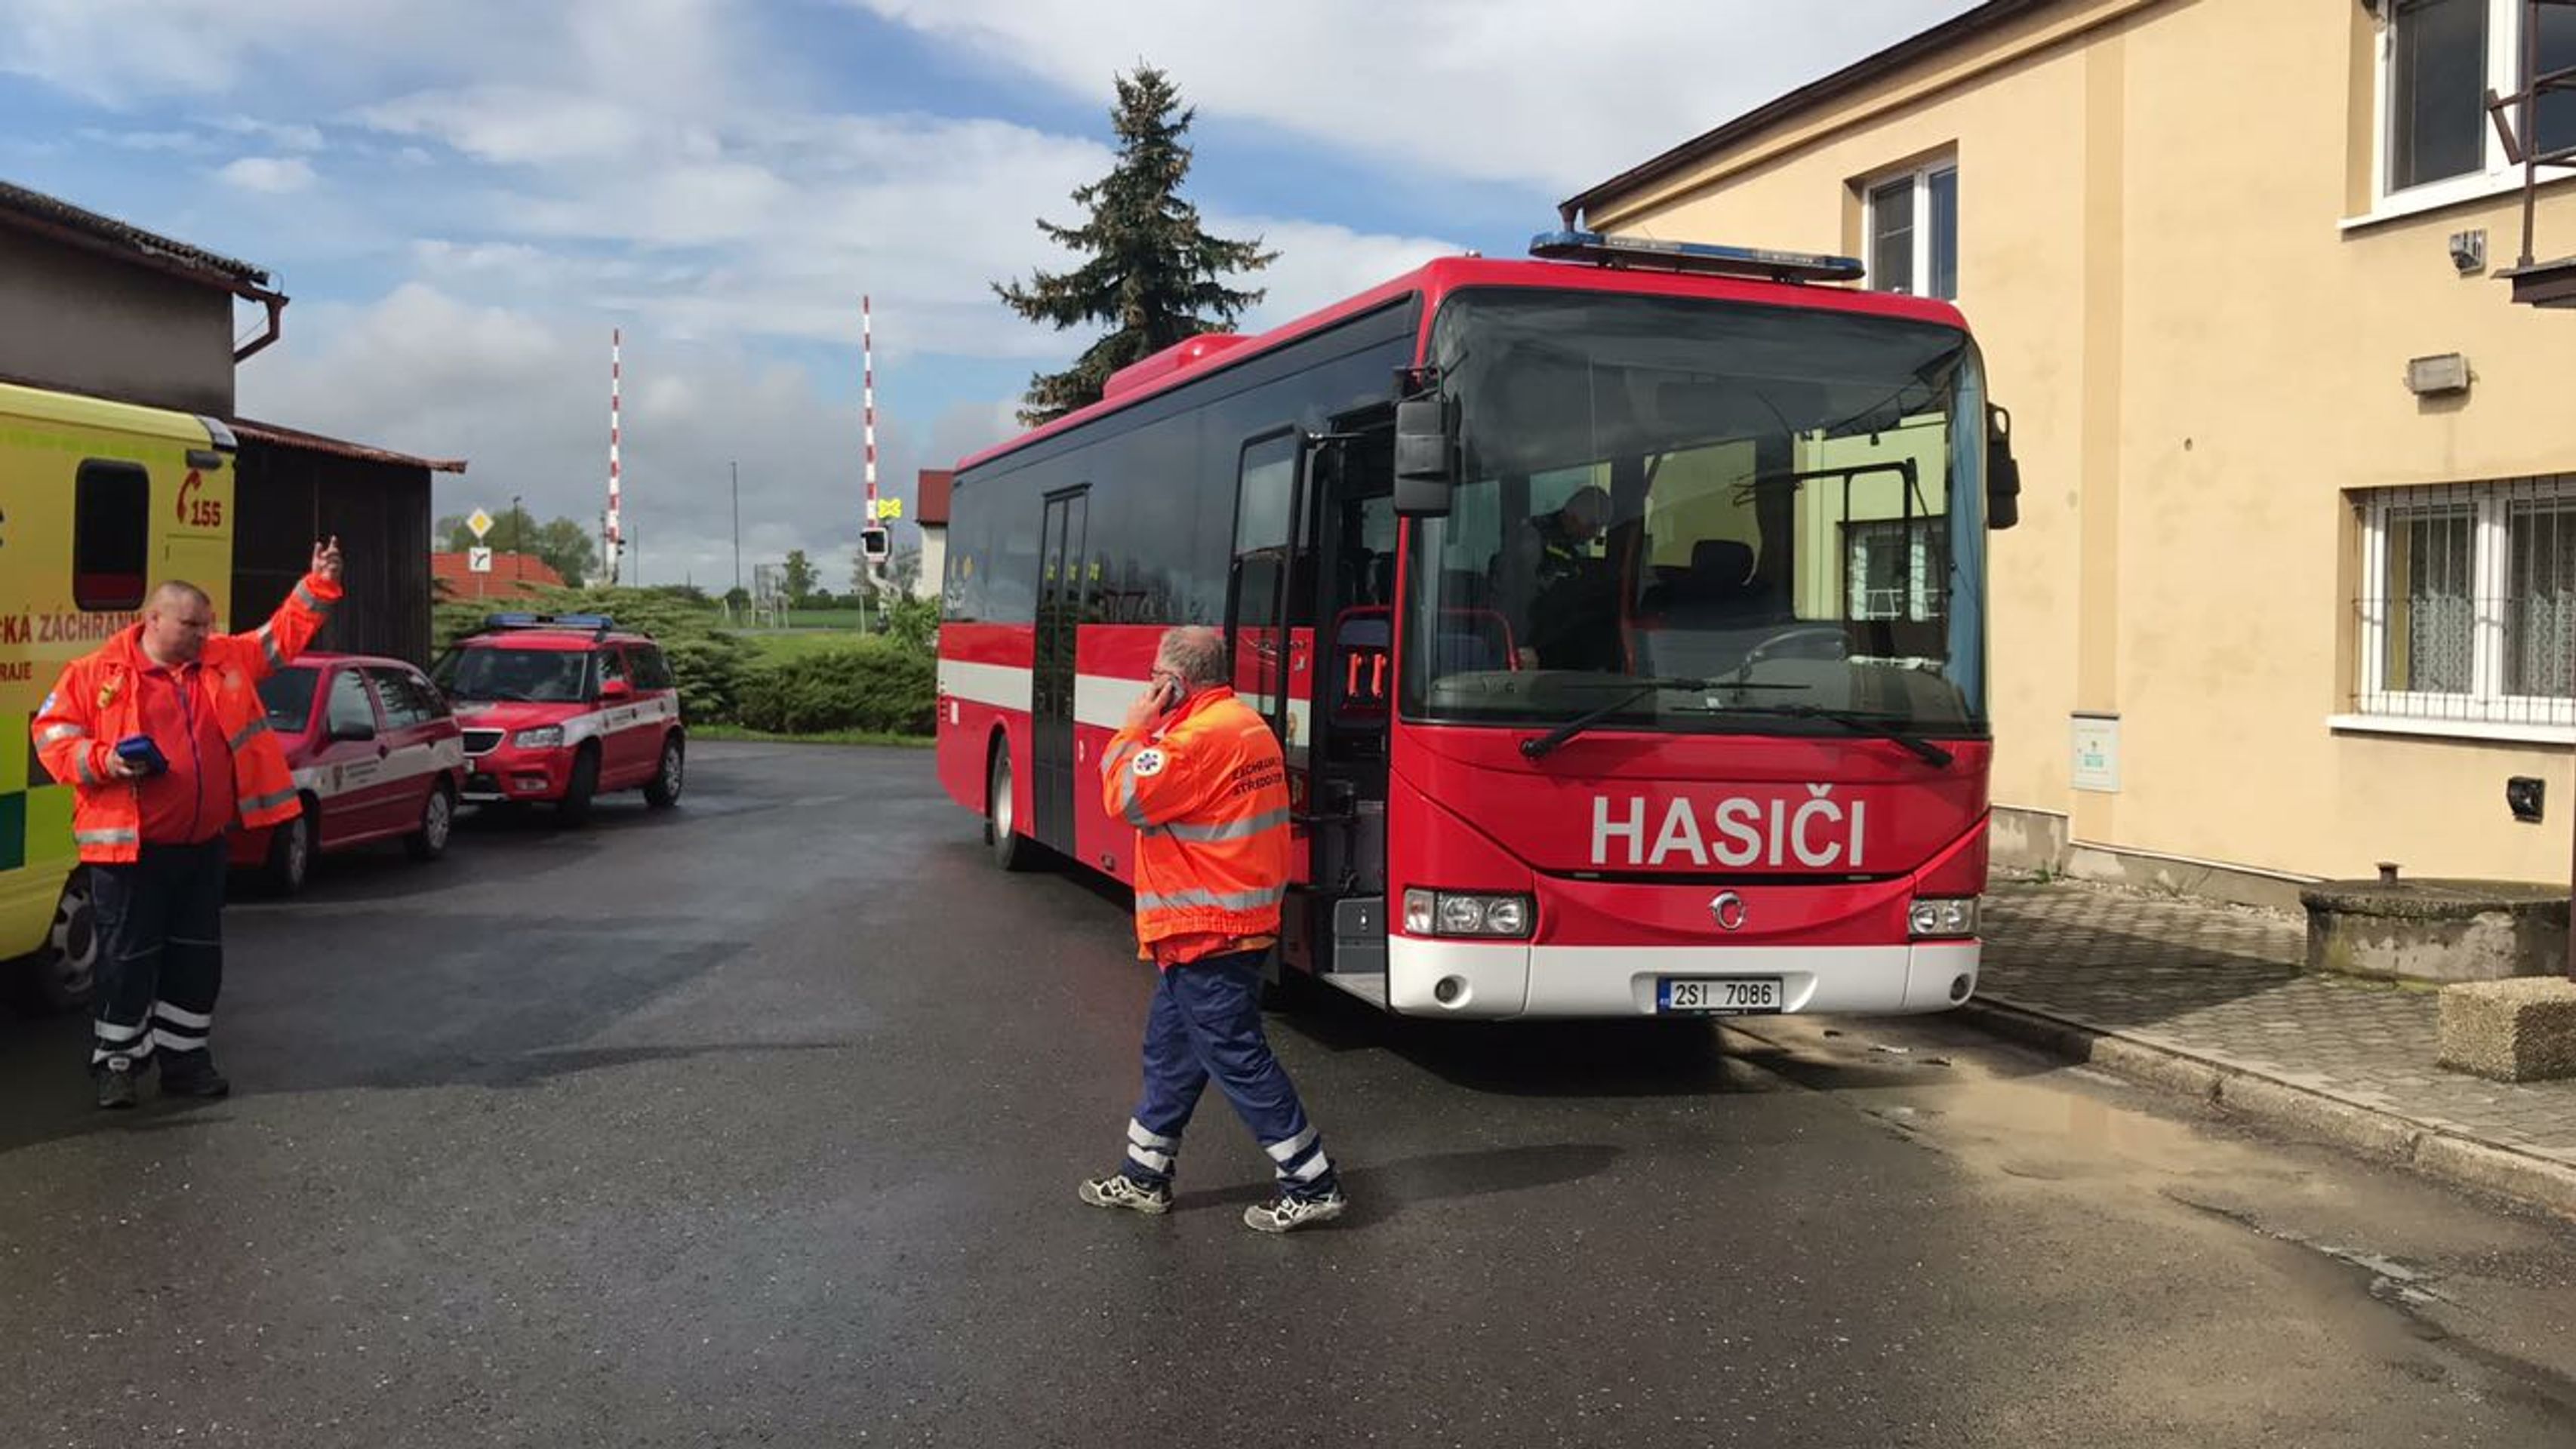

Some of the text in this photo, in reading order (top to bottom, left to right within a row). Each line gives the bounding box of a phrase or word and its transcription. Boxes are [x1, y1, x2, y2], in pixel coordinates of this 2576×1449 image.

[191, 500, 221, 527] 155
[0, 605, 32, 644] KÁ
[1591, 783, 1865, 867] HASIČI
[1675, 984, 1772, 1005] 2SI 7086
